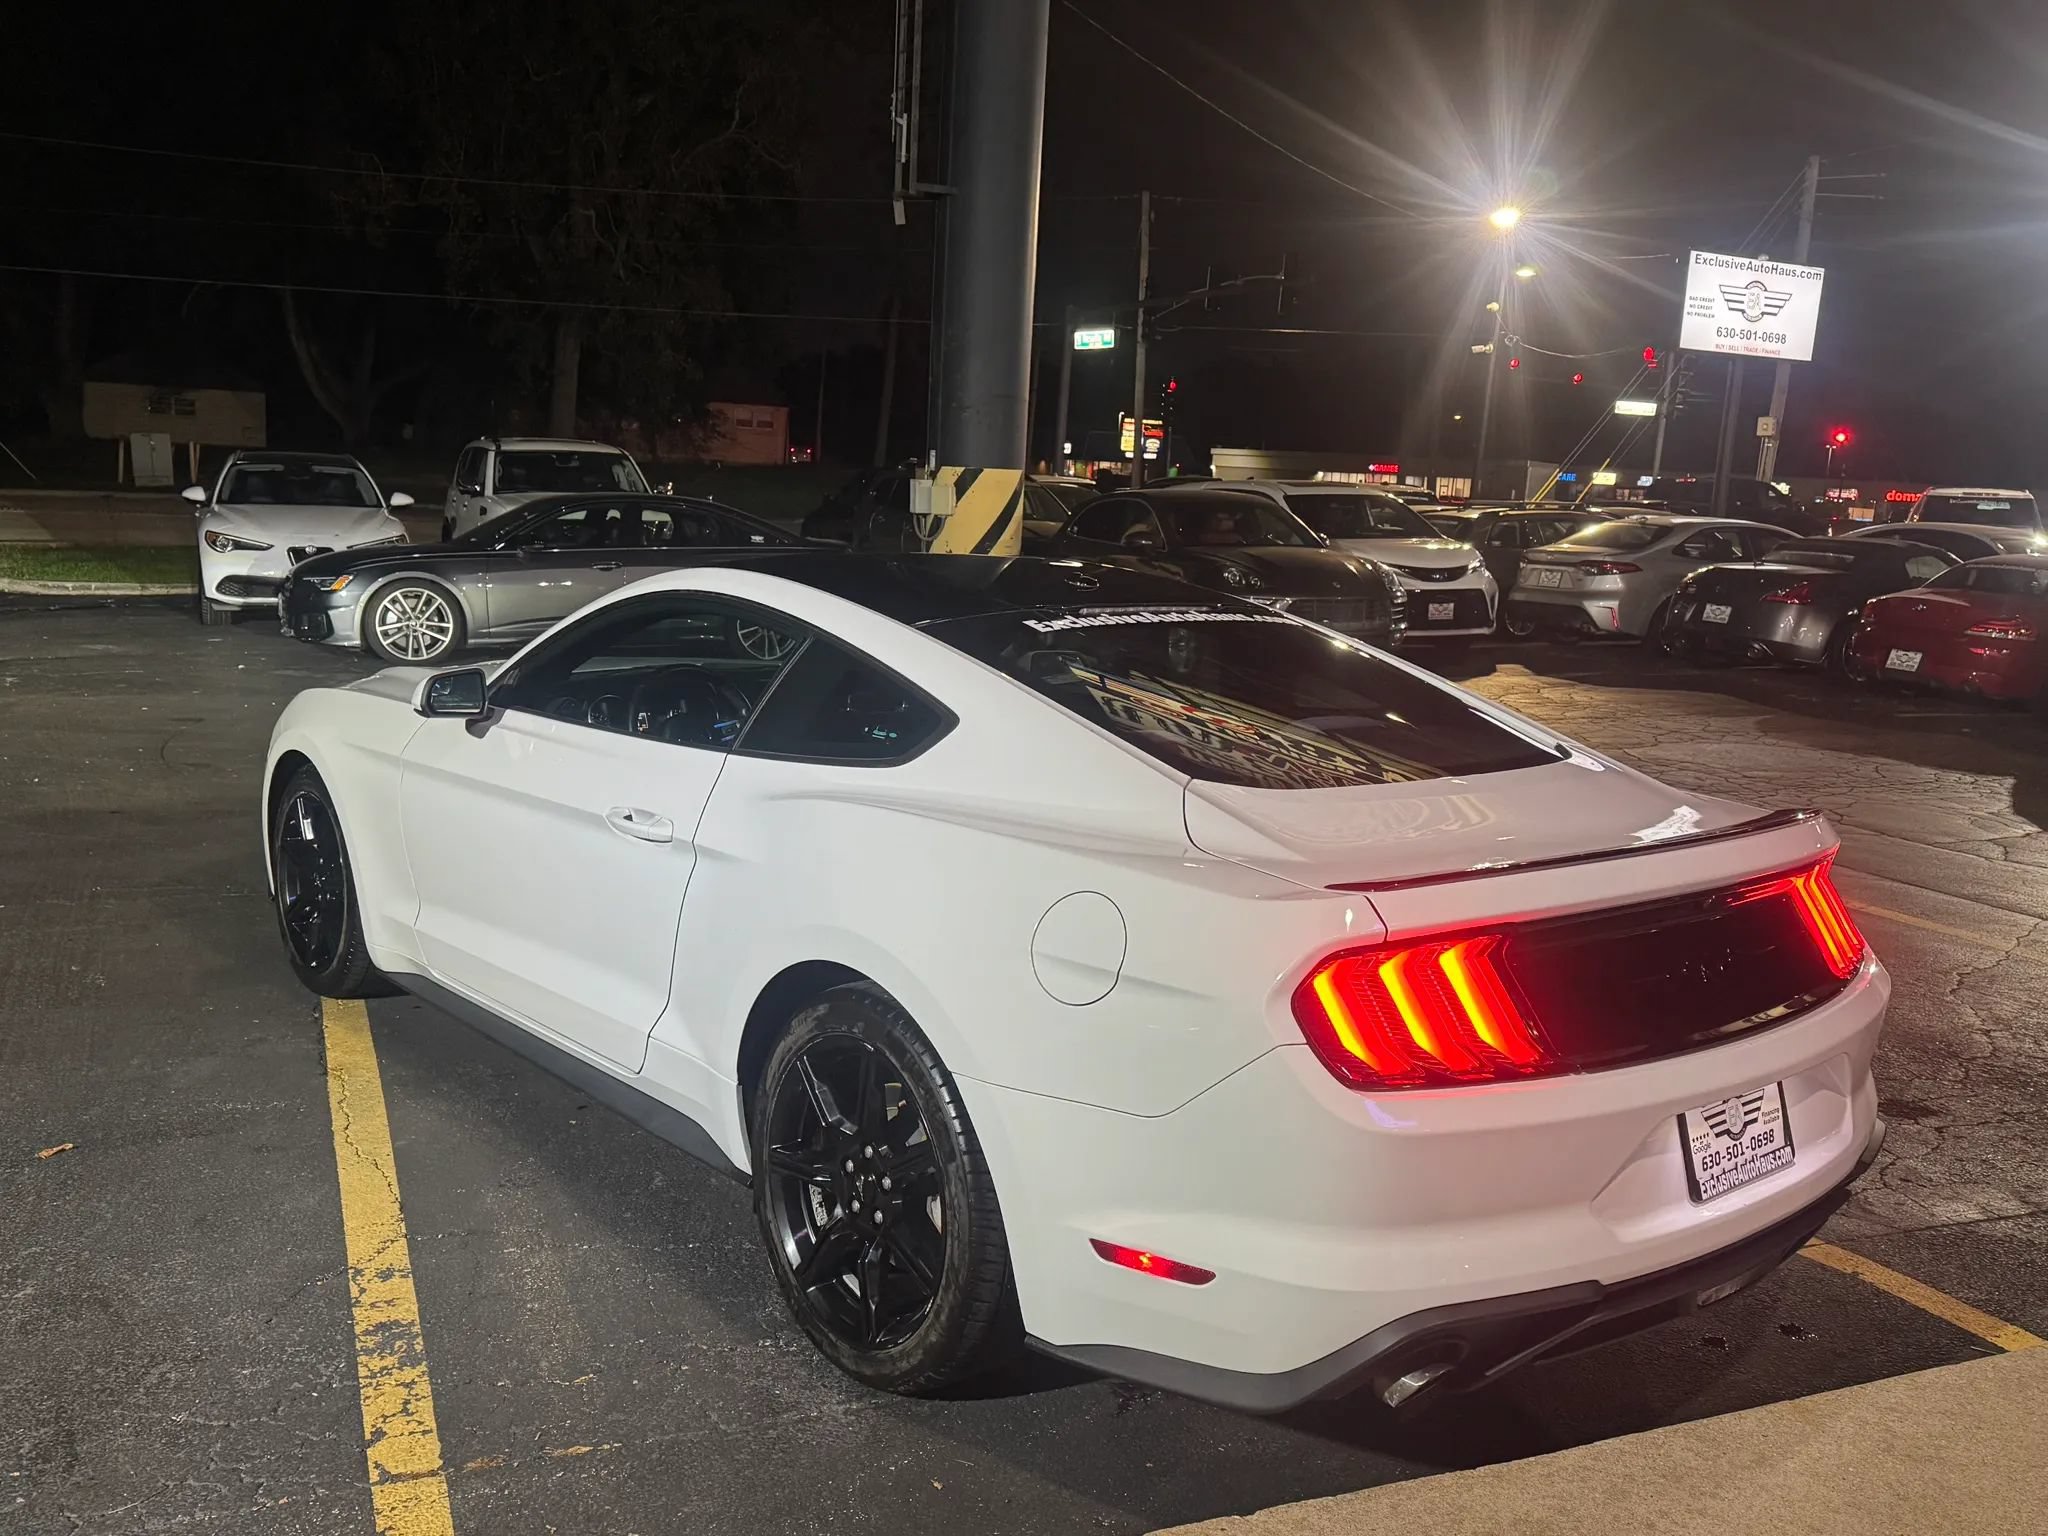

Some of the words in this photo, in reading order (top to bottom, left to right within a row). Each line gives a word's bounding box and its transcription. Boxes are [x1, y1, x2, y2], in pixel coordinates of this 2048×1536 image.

[1695, 254, 1822, 281] ExclusiveAutoHaus.com
[1716, 326, 1787, 344] 630-501-0698
[1693, 1140, 1711, 1155] Google
[1702, 1129, 1775, 1172] 630-501-0698
[1701, 1145, 1793, 1200] ExclusiveAutoHaus.com
